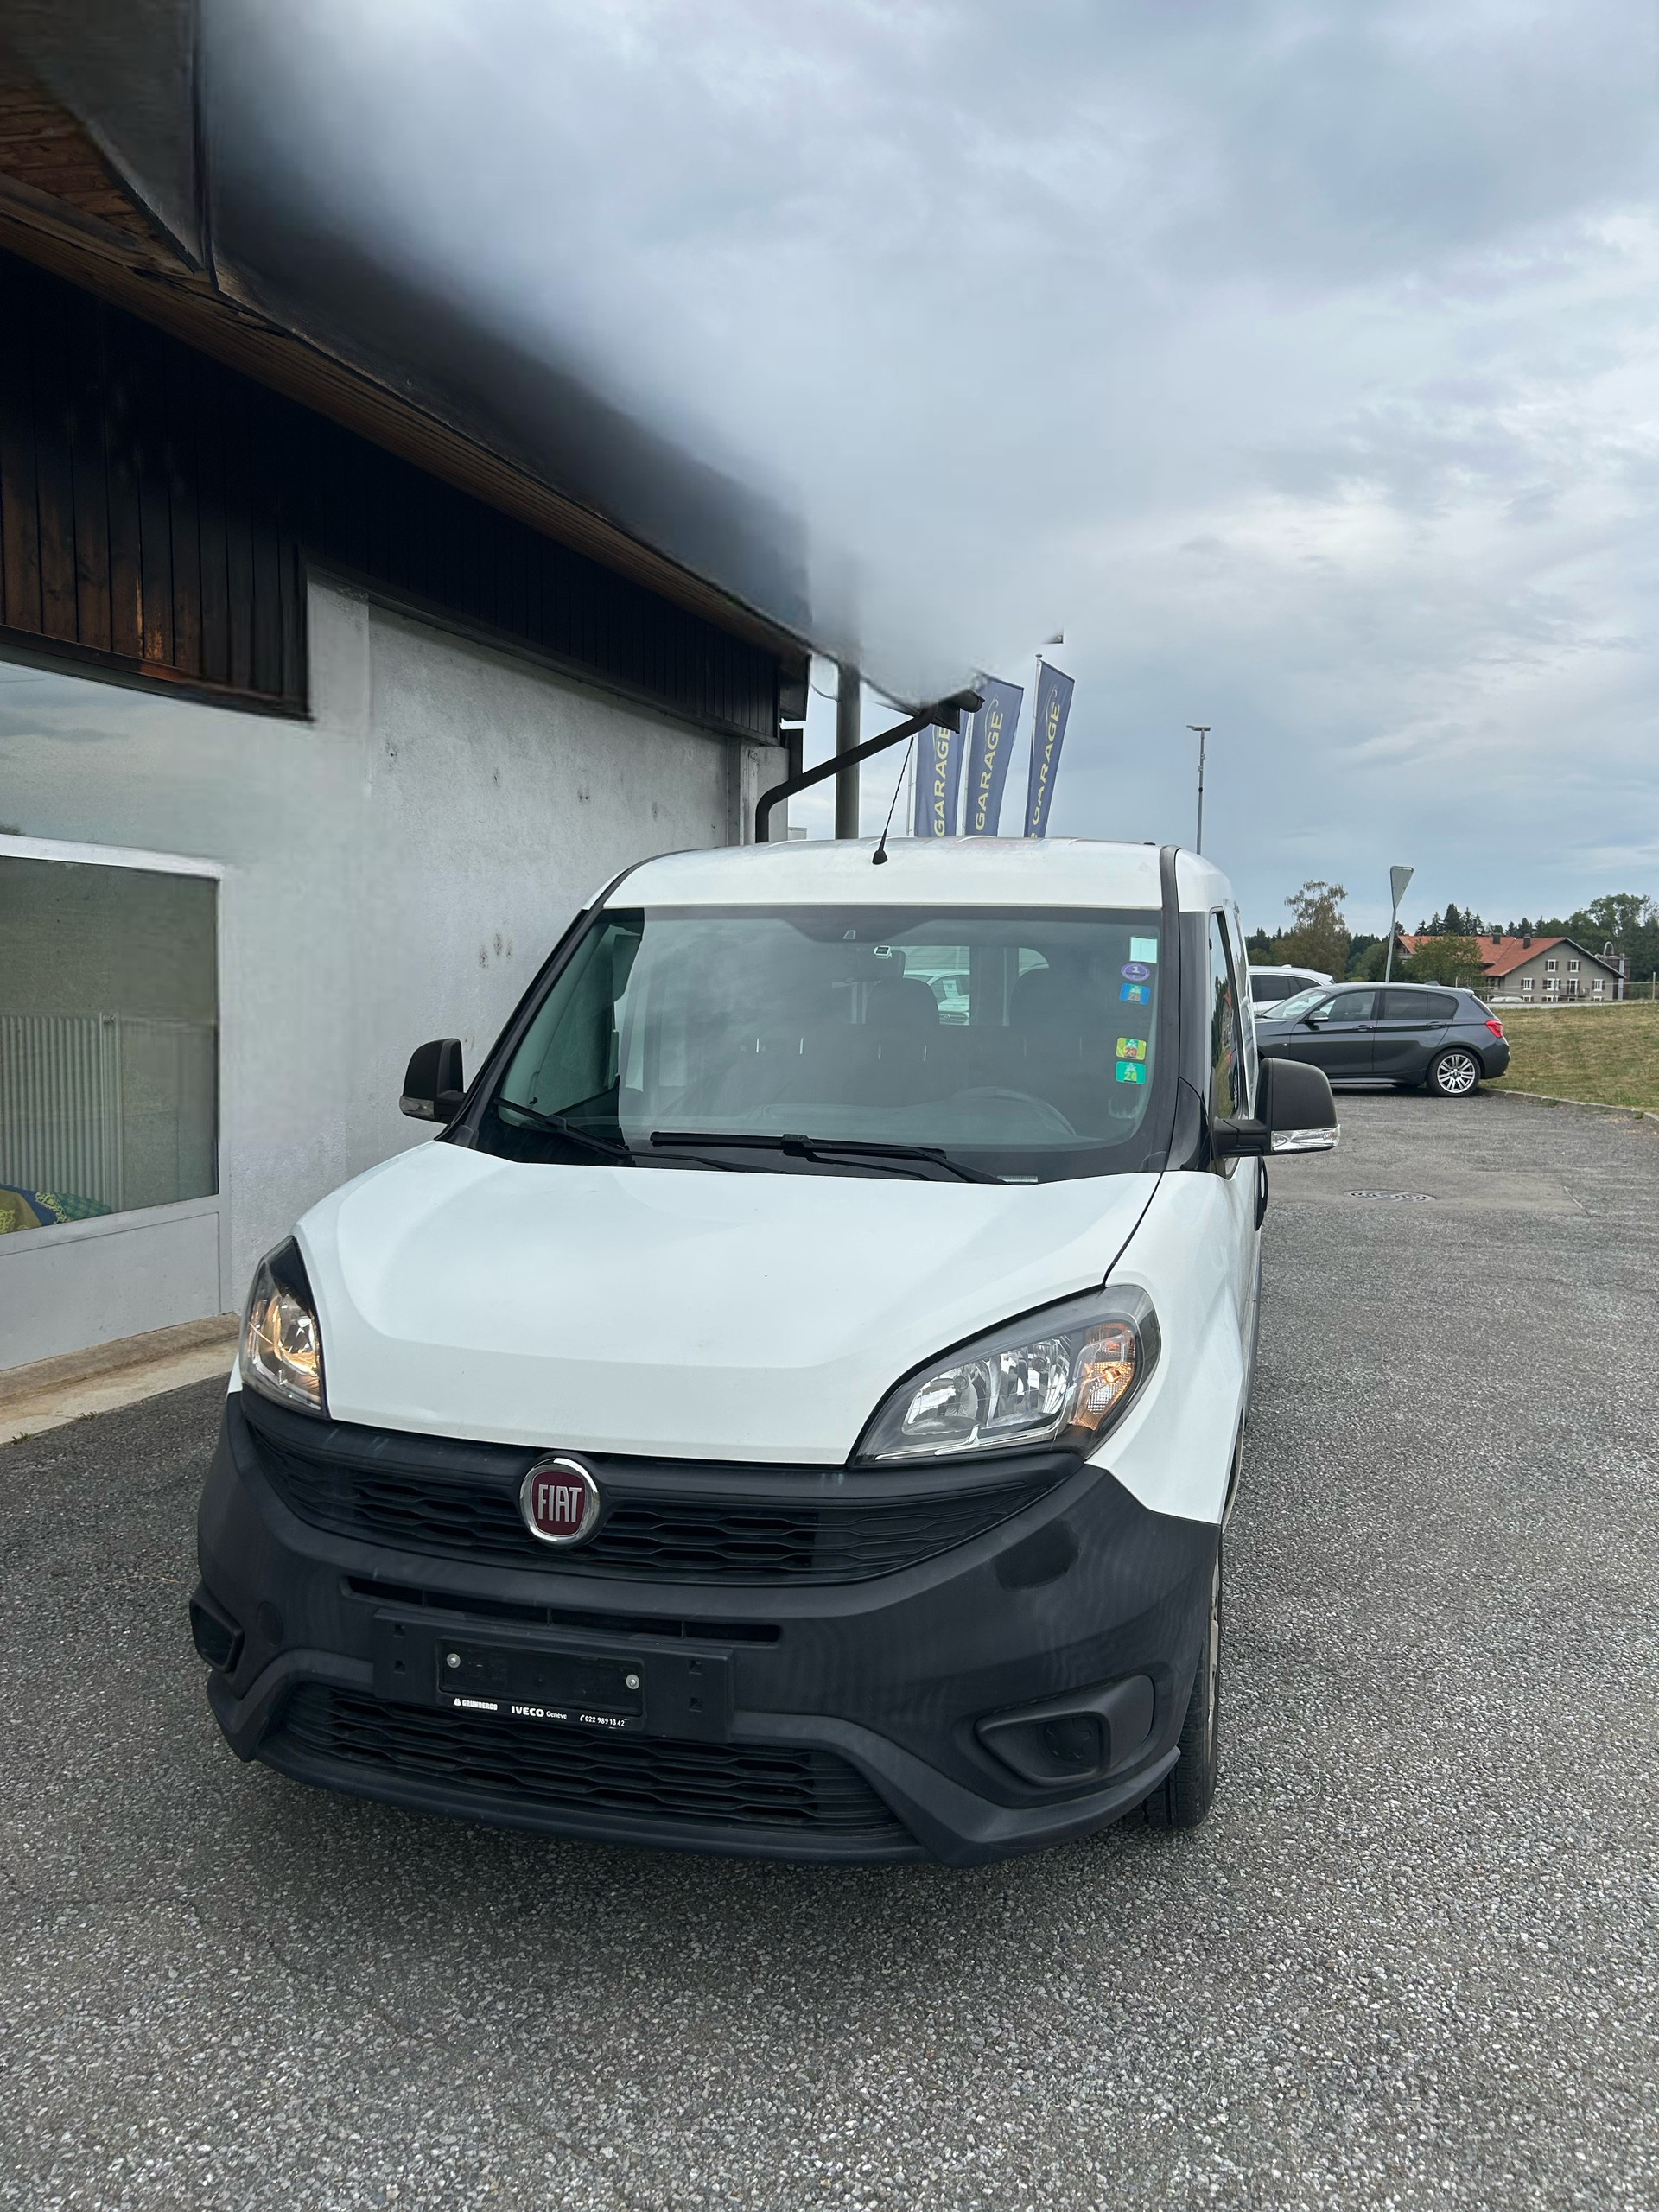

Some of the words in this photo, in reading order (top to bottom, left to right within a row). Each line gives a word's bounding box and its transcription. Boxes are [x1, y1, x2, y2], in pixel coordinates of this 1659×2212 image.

[933, 727, 951, 837] GARAGE
[976, 710, 1004, 831] GARAGE
[1132, 965, 1140, 974] 1
[537, 1484, 582, 1522] FIAT
[461, 1700, 498, 1711] GRUNDERCO
[511, 1705, 544, 1717] IVECO
